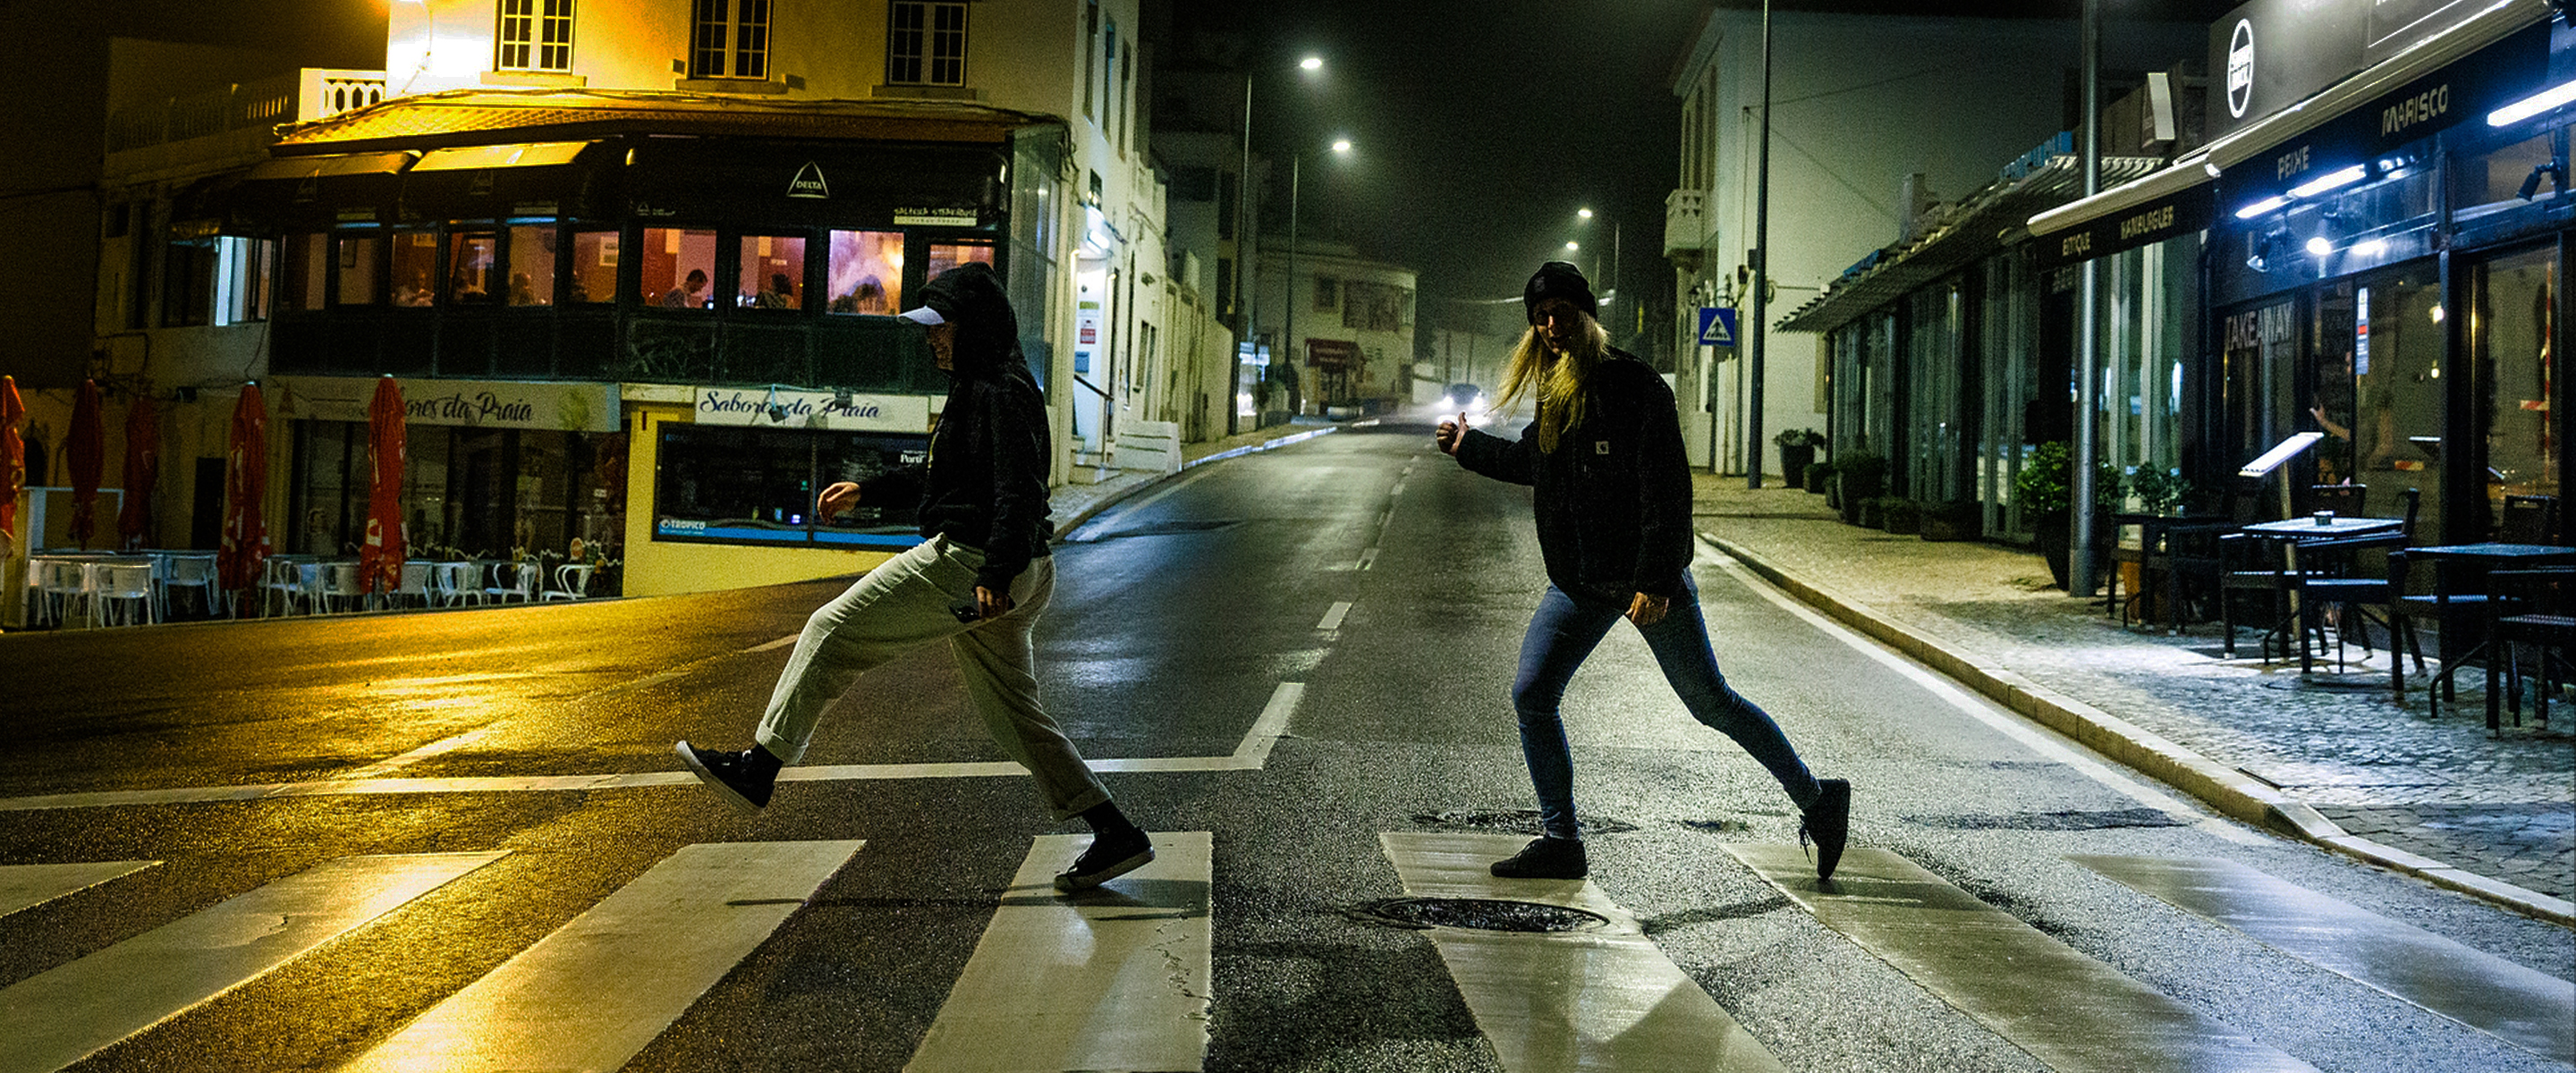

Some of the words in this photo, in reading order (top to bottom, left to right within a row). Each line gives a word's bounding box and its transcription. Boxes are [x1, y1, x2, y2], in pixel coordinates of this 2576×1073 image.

[2381, 84, 2449, 137] MARISCO
[2277, 145, 2310, 181] PEIXE
[796, 181, 822, 190] DELTA
[2224, 301, 2295, 351] TAKEAWAY
[443, 393, 471, 418] da
[475, 392, 532, 424] Praia
[699, 390, 775, 413] Sabore
[786, 398, 812, 415] da
